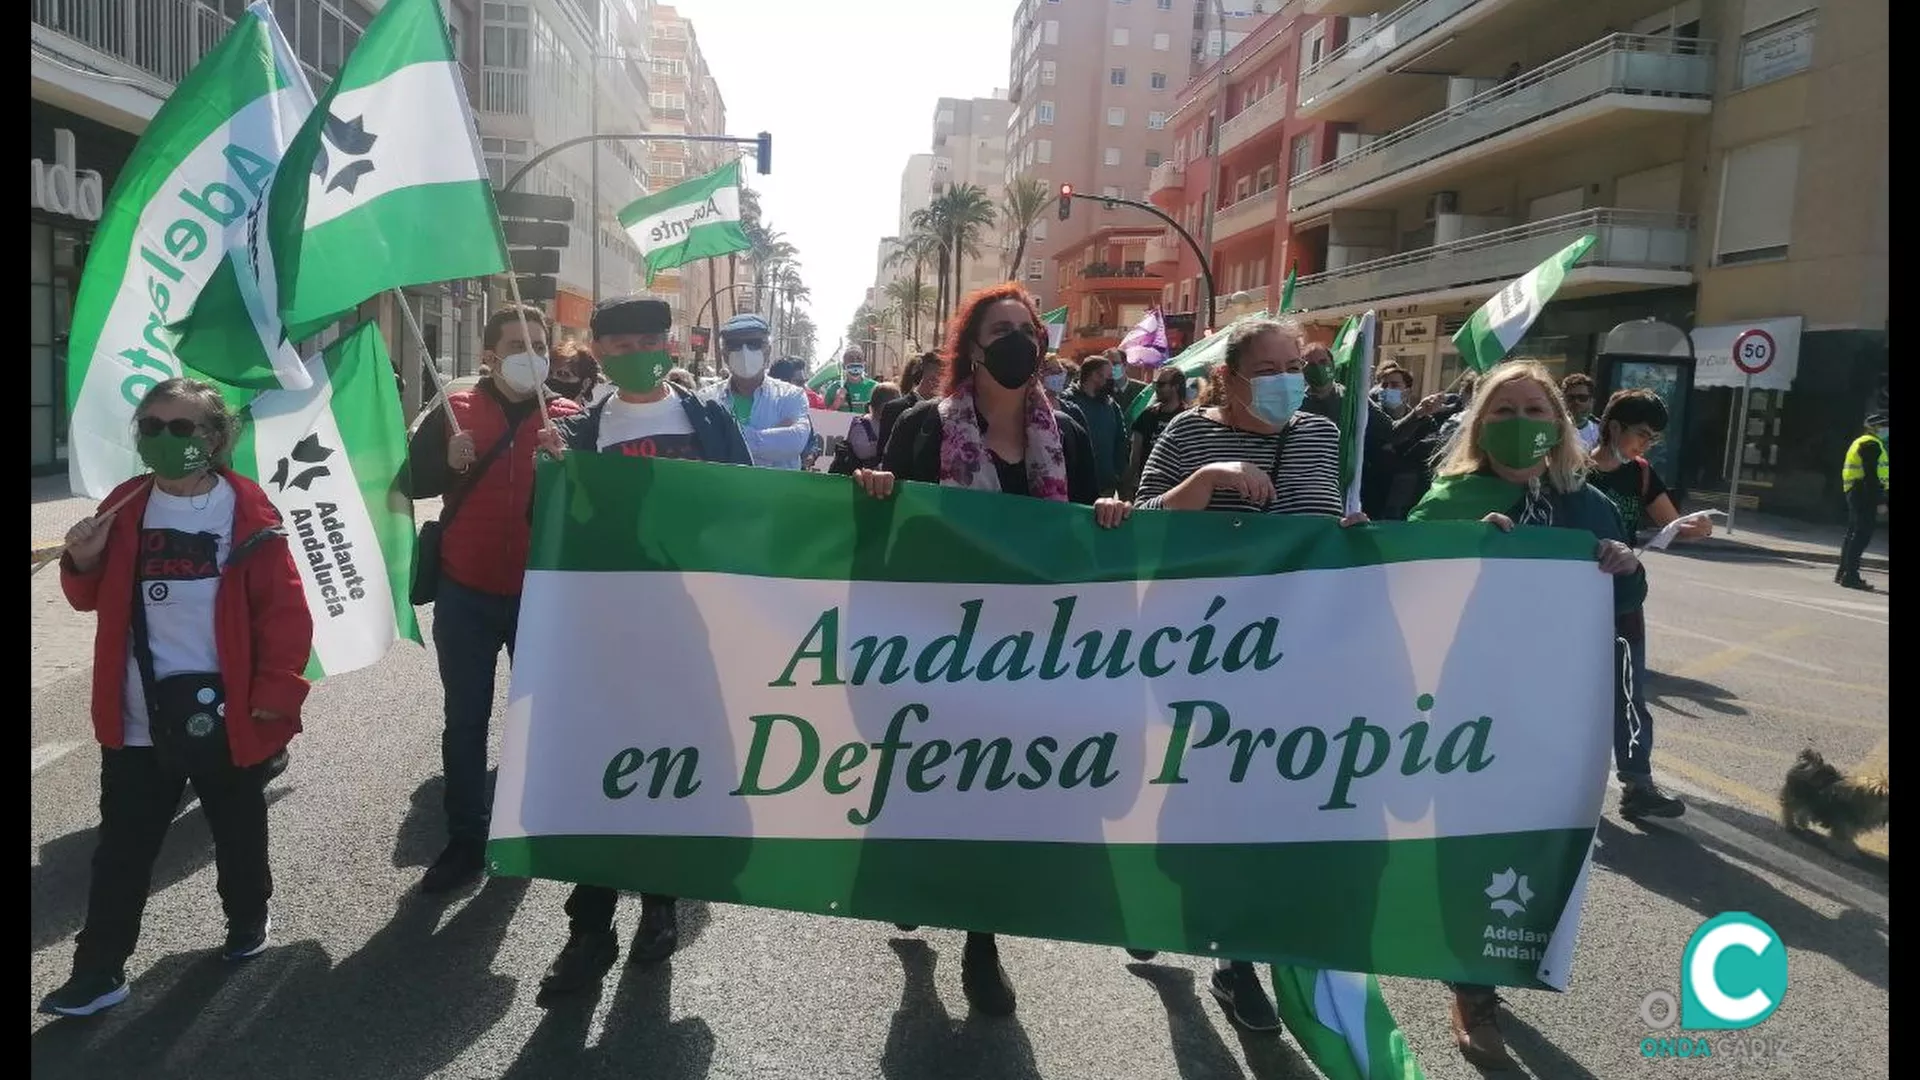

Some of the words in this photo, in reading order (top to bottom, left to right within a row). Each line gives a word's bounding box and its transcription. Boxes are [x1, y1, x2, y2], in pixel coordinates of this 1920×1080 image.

[1744, 343, 1766, 359] 50
[289, 508, 347, 619] Andalucía
[315, 501, 366, 601] Adelante
[768, 595, 1284, 688] Andalucía
[601, 742, 703, 803] en
[729, 703, 1120, 826] Defensa
[1148, 692, 1496, 812] Propia
[1483, 924, 1553, 944] Adelan
